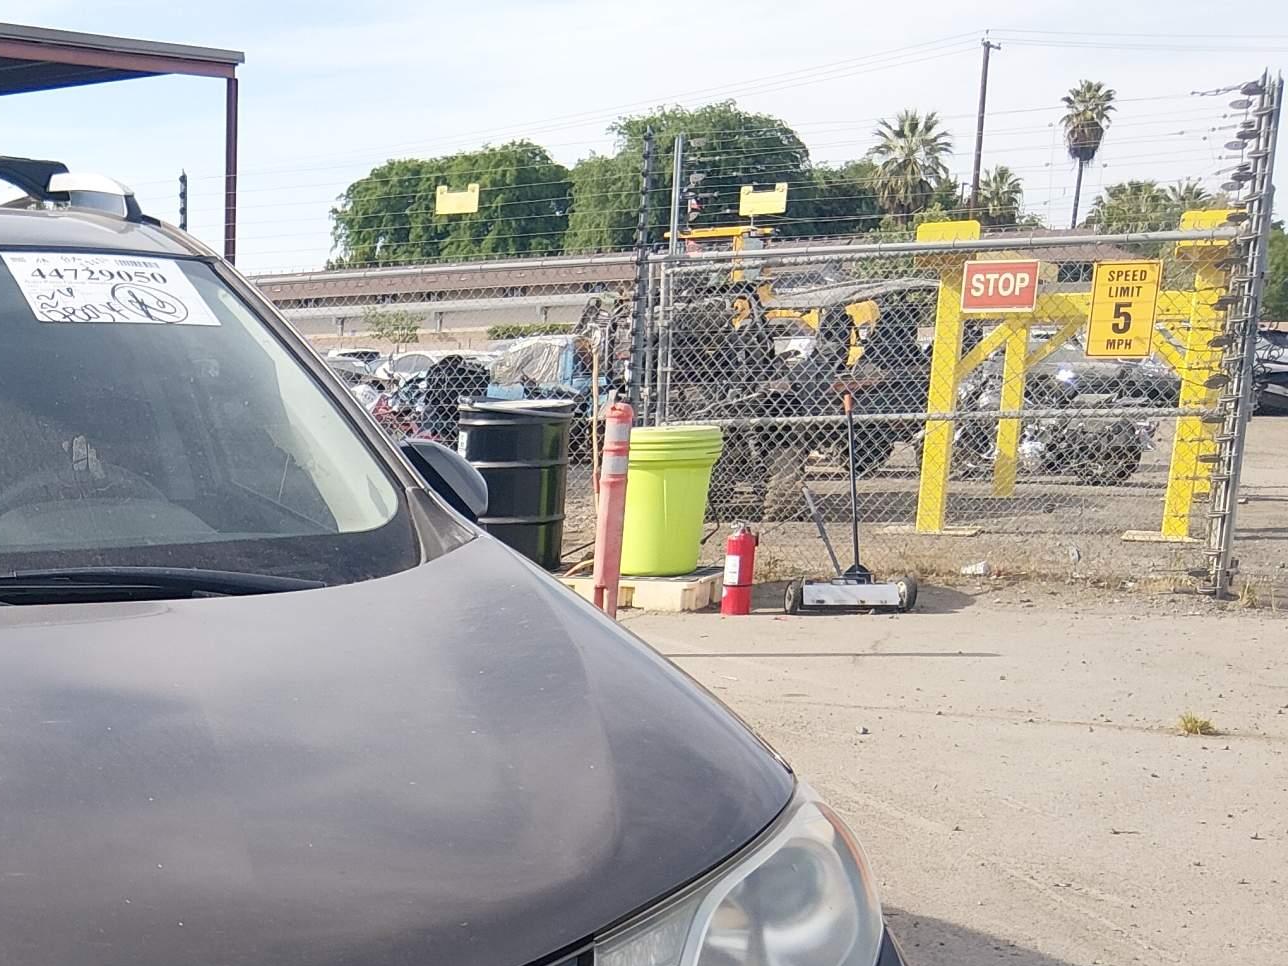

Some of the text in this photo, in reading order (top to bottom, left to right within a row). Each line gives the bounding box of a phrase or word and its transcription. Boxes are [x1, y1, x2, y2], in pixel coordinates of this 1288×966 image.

[31, 266, 168, 285] 44729050
[1107, 270, 1147, 282] SPEED
[970, 272, 1030, 298] STOP
[1108, 285, 1143, 298] LIMIT
[1111, 301, 1133, 335] 5
[1105, 338, 1133, 351] MPH
